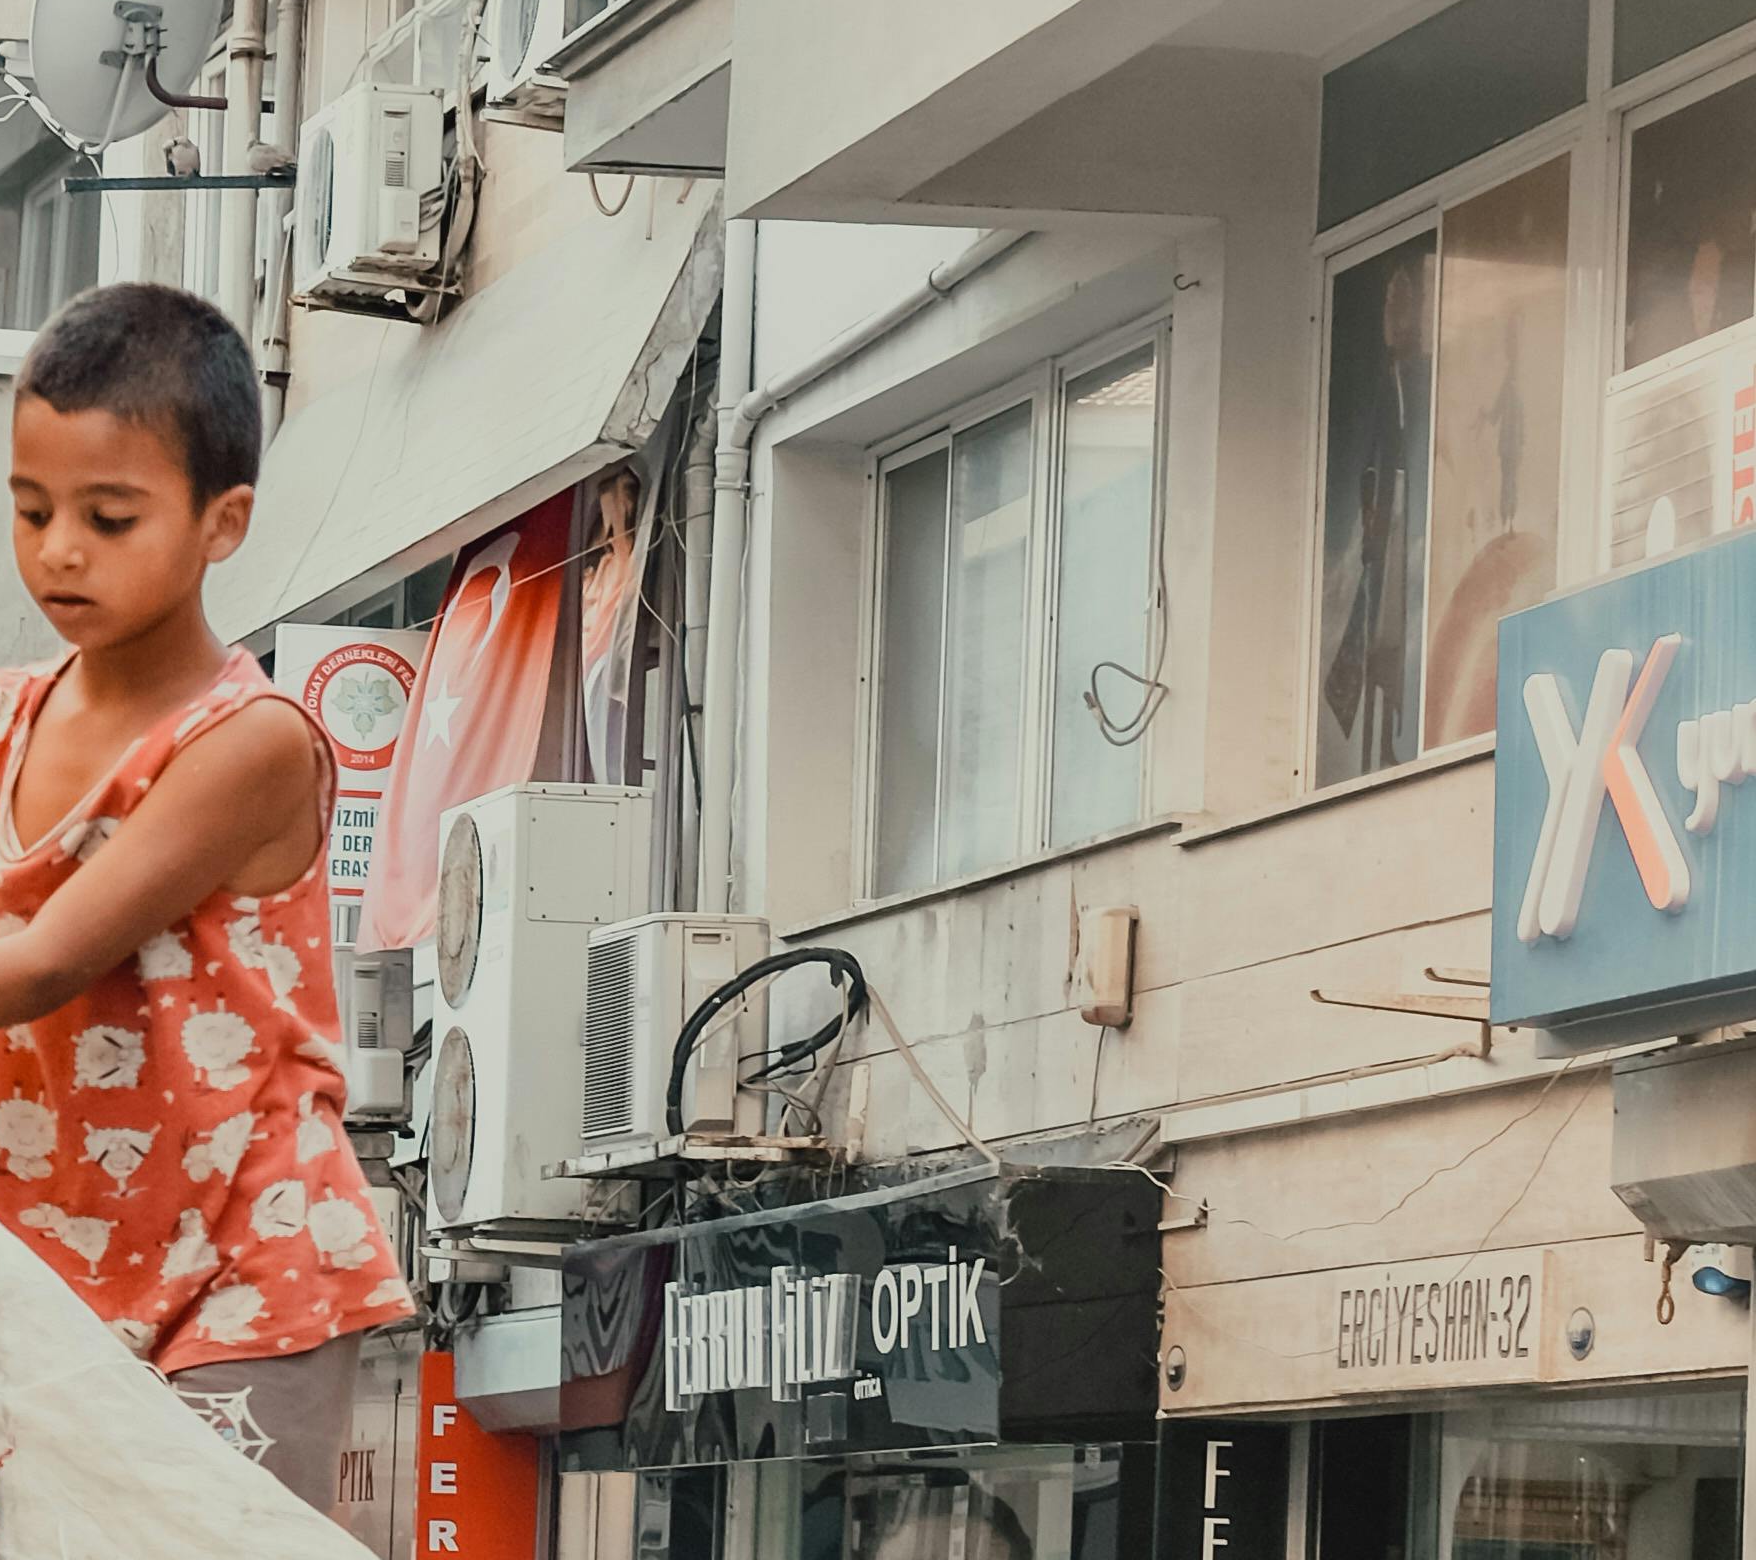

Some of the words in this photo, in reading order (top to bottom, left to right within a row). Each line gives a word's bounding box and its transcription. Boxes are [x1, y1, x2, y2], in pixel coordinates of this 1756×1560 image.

[350, 753, 376, 765] 2014
[337, 804, 379, 829] İZMİ
[871, 1244, 987, 1355] OPTİK
